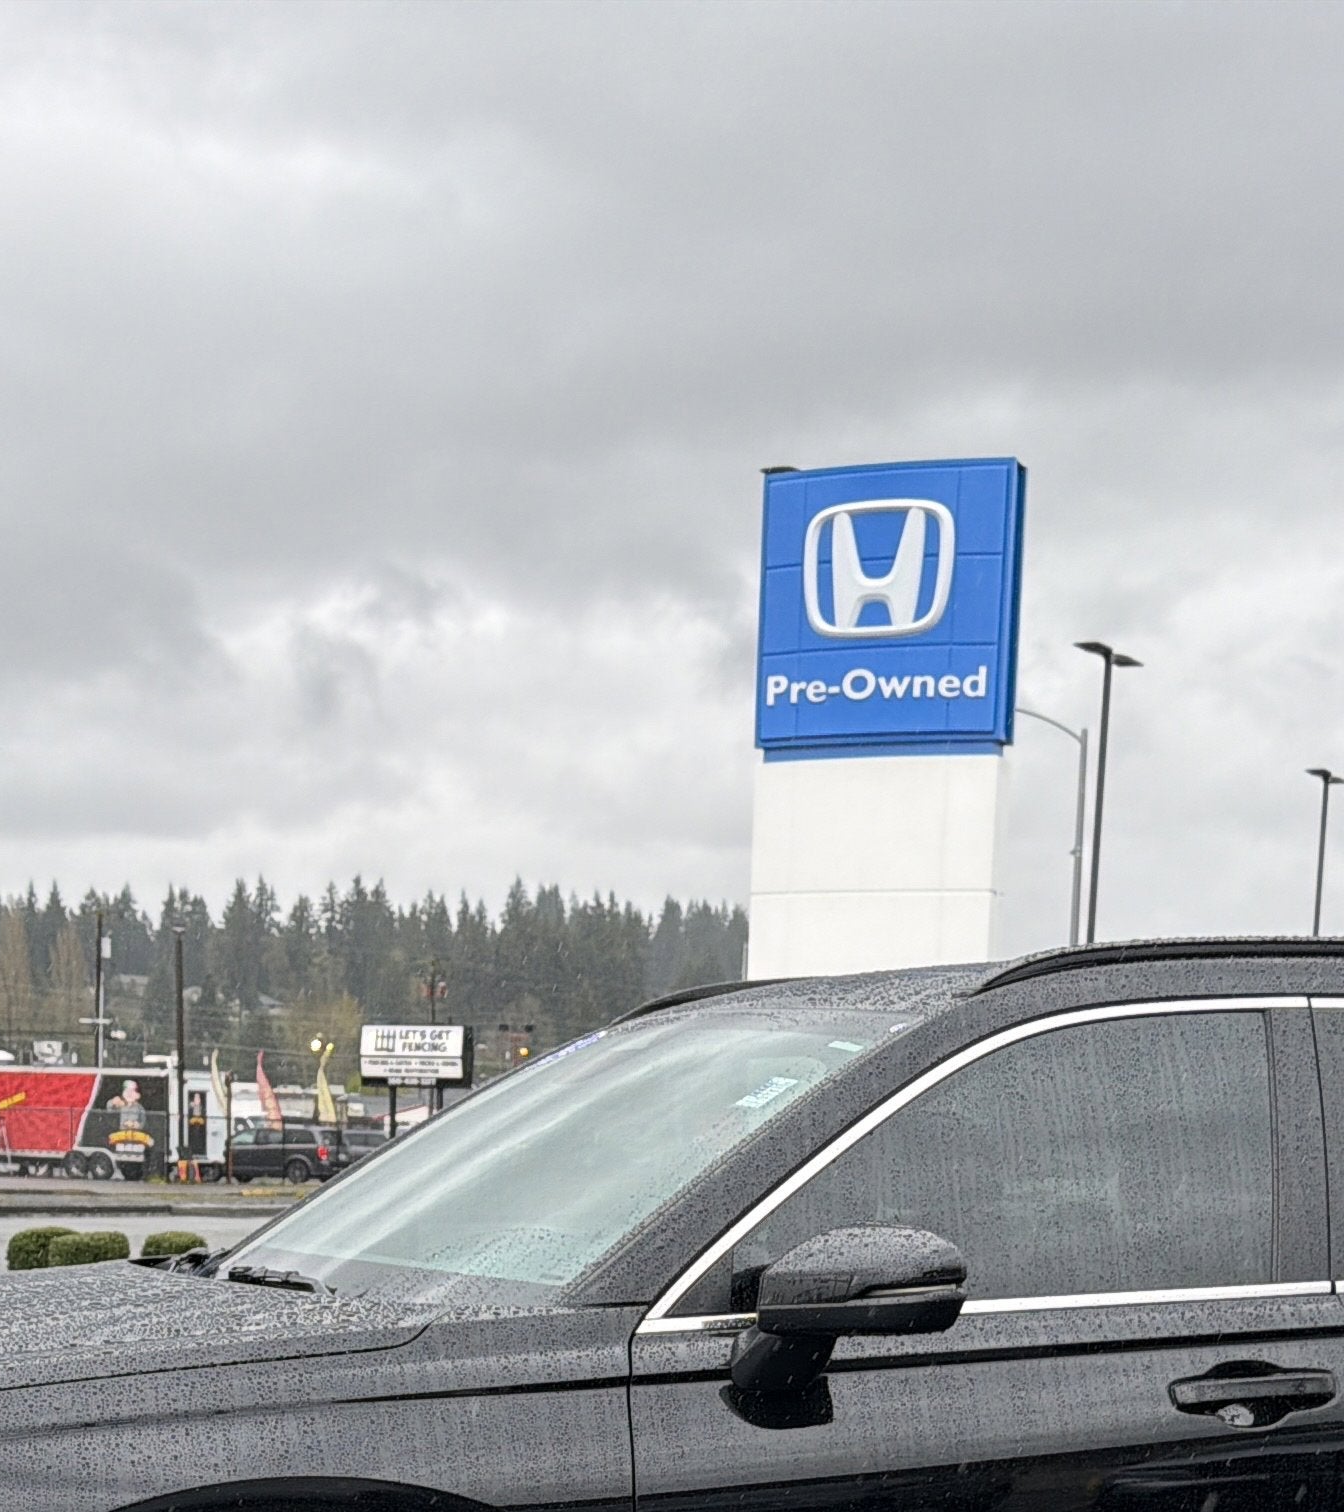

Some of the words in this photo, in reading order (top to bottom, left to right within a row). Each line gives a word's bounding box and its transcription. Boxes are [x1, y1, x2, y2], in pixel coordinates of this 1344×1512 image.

[765, 665, 988, 706] Pre-Owned
[399, 1029, 427, 1041] LET'S
[430, 1029, 452, 1041] GET
[402, 1042, 447, 1053] FENCING
